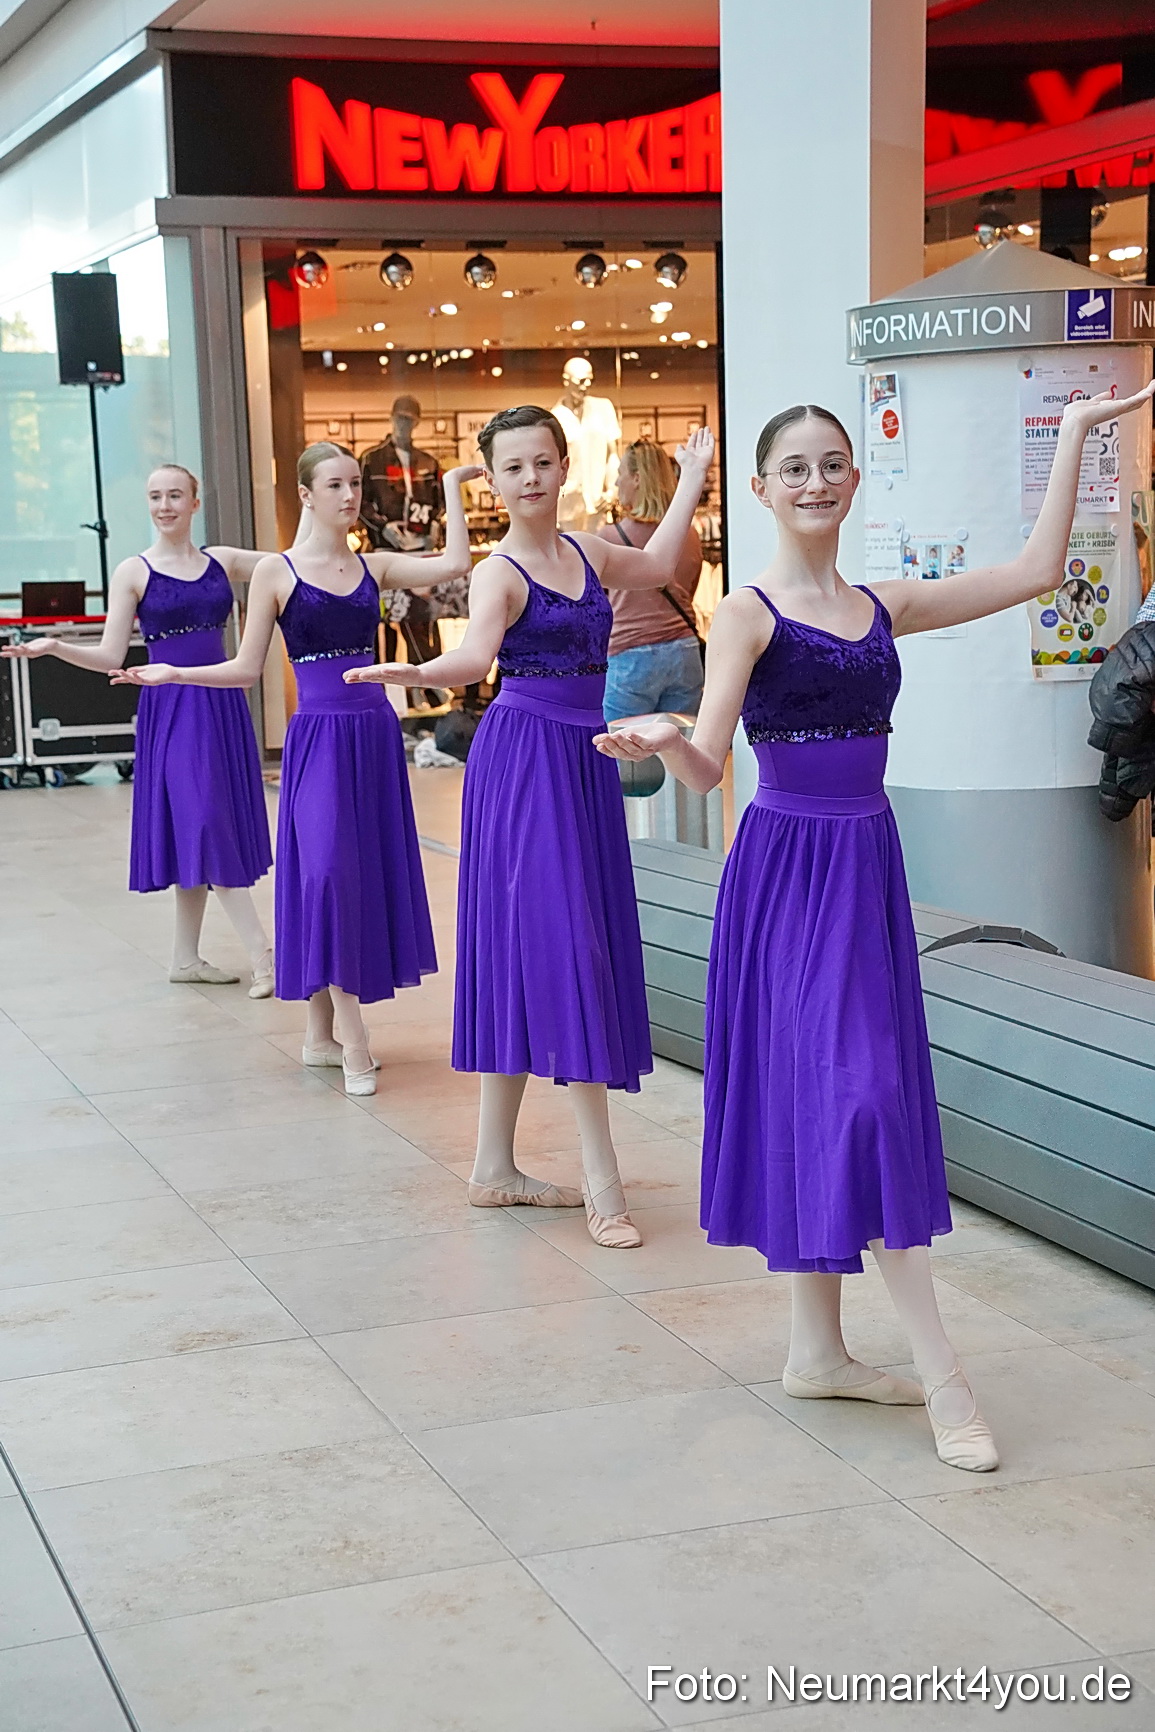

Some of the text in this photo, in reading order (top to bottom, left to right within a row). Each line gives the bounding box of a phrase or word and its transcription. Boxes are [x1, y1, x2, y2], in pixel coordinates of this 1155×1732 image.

[1133, 301, 1155, 329] IN
[850, 304, 1031, 347] INFORMATION
[1043, 395, 1068, 404] REPAIR
[1025, 416, 1063, 427] REPARIE
[1025, 428, 1050, 438] STATT
[1076, 496, 1107, 504] EUMARKT
[409, 502, 433, 524] 24
[1092, 540, 1116, 548] KRISEN
